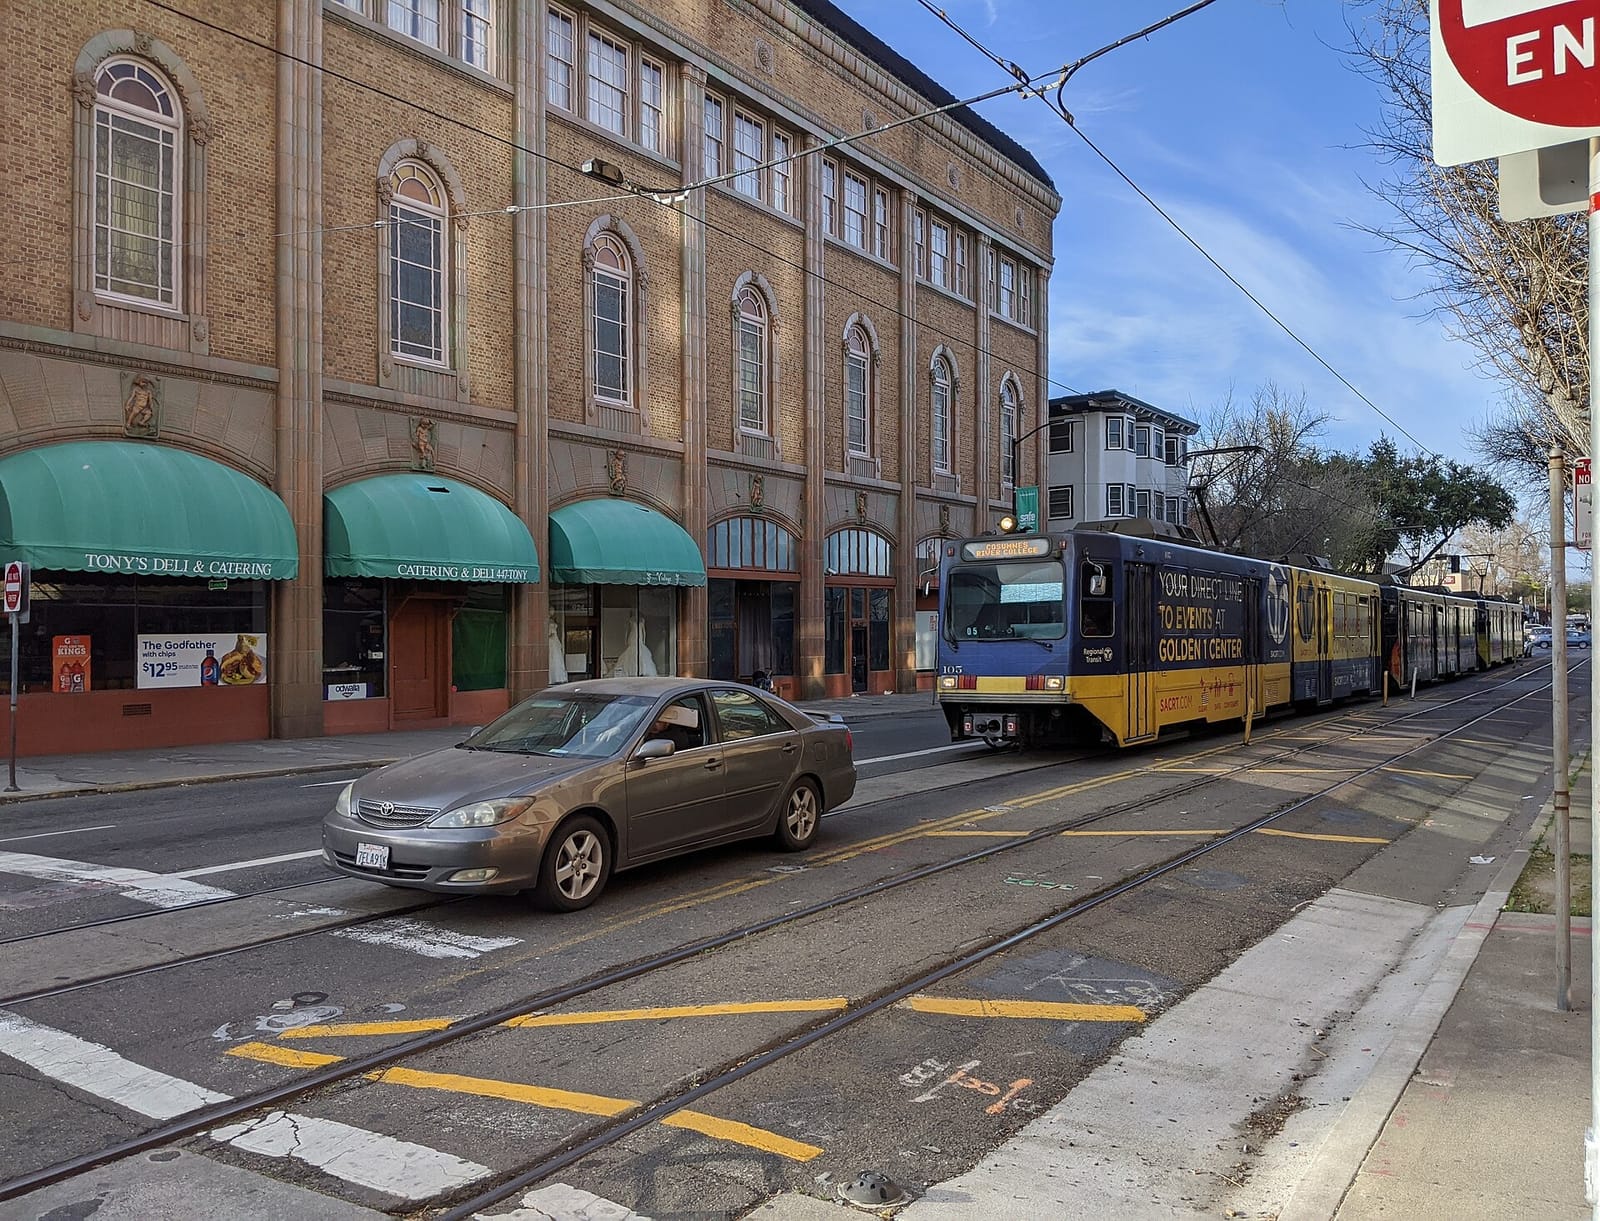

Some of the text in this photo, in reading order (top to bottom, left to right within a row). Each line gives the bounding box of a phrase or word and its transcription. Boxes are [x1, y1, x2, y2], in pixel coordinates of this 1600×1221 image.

[1506, 17, 1595, 87] EN
[1020, 511, 1036, 523] safe
[986, 541, 1029, 551] COSUMNES
[976, 546, 1038, 558] RIVER COLLEGE
[85, 553, 272, 576] TONY'S DELI & CATERING
[397, 564, 458, 578] CATERING
[461, 567, 469, 578] &
[473, 568, 494, 579] DELI
[1158, 571, 1243, 603] YOUR DIRECT LINE
[1160, 605, 1226, 630] TO EVENTS AT
[64, 637, 71, 645] G
[142, 640, 216, 650] The Godfather
[58, 647, 87, 656] KINGS
[158, 651, 176, 659] chips
[1083, 647, 1104, 656] Regional
[1158, 638, 1243, 662] GOLDEN 1 CENTER
[1085, 655, 1103, 663] Transit
[943, 665, 963, 674] 105
[335, 684, 360, 692] odwalla
